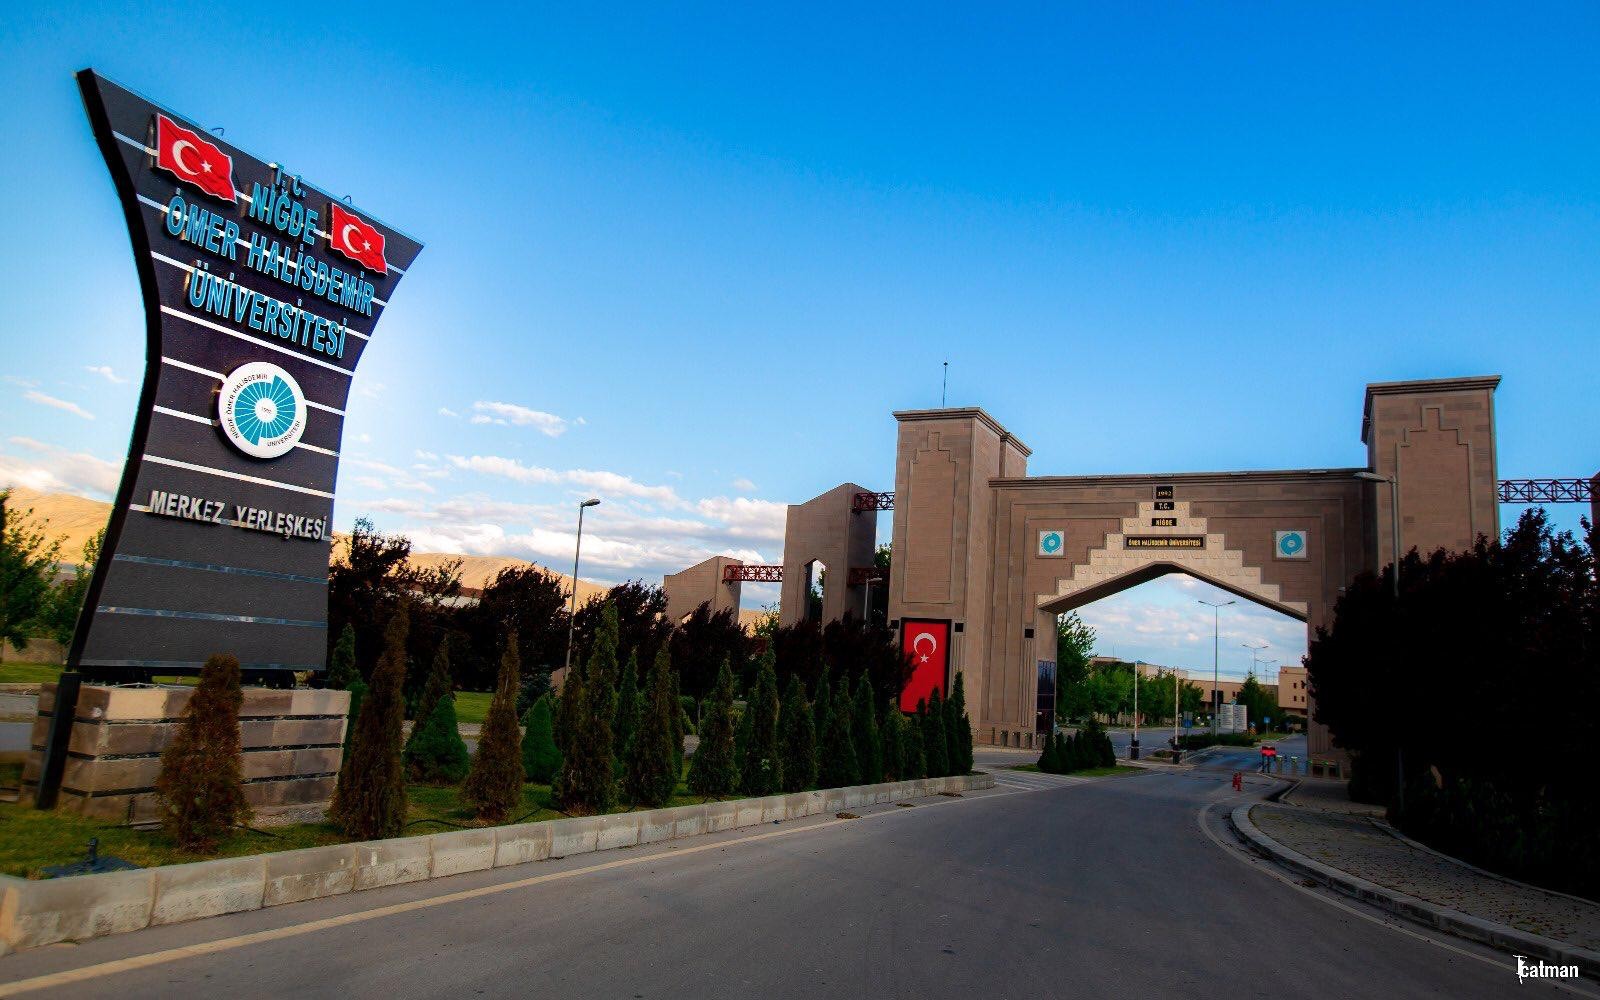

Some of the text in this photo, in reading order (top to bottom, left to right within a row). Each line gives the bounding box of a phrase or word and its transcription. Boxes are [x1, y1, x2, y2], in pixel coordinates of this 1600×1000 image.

[250, 181, 319, 245] NİĞDE
[166, 188, 375, 316] ÖMER HALİSDEMİR
[189, 260, 348, 359] ÜNİVERSİTESİ
[150, 490, 327, 540] MERKEZ YERLEŞKESİ
[1155, 518, 1173, 526] NİĞDE
